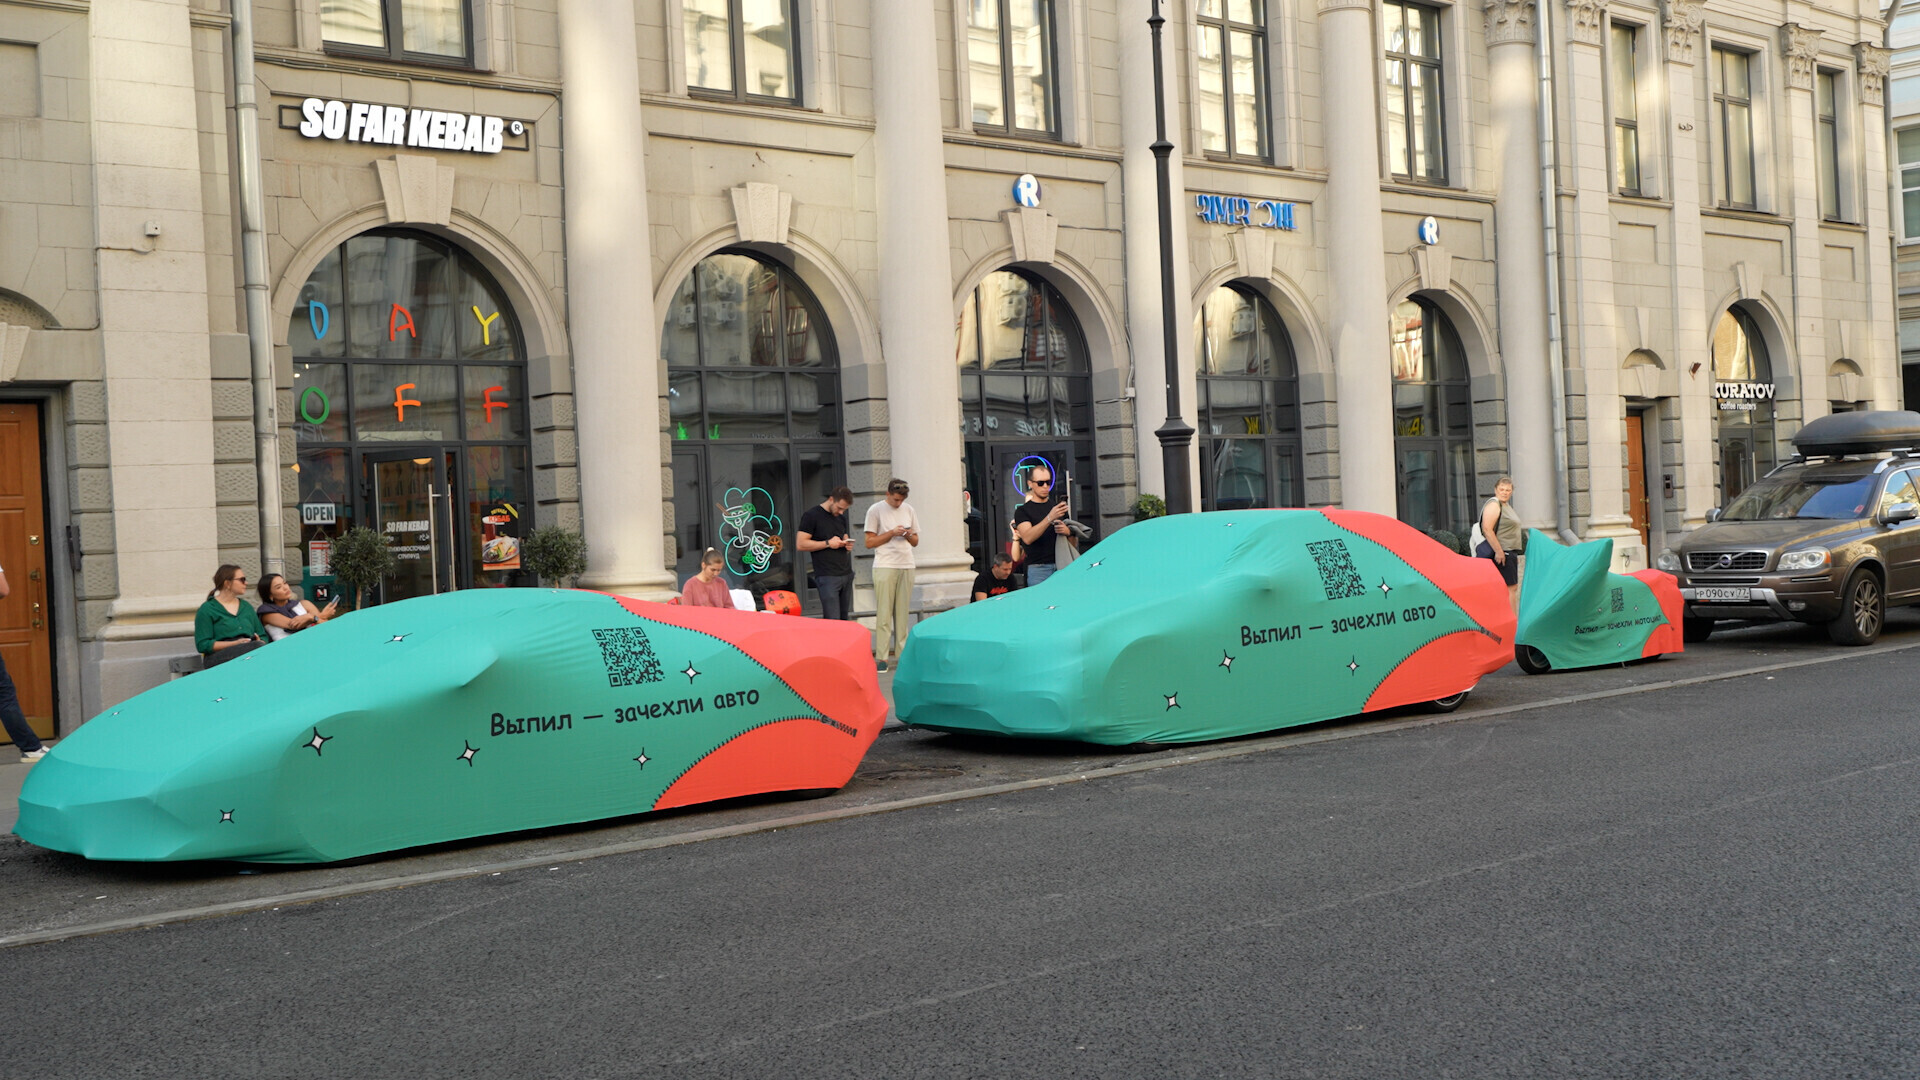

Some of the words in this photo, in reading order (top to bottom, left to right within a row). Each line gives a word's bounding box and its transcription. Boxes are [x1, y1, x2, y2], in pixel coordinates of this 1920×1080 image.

[300, 97, 347, 140] SO
[348, 102, 407, 145] FAR
[407, 108, 504, 154] KEBAB
[305, 506, 334, 521] OPEN
[386, 521, 396, 533] SO
[396, 521, 408, 532] FAR
[408, 520, 429, 531] KEBAB
[1241, 624, 1301, 647] Выпил
[1331, 610, 1396, 634] зачехли
[1402, 604, 1436, 622] авто
[1574, 625, 1599, 635] Выпил
[1607, 620, 1633, 630] зачехли
[490, 711, 573, 736] Выпил
[614, 696, 704, 724] зачехли
[713, 687, 760, 709] авто
